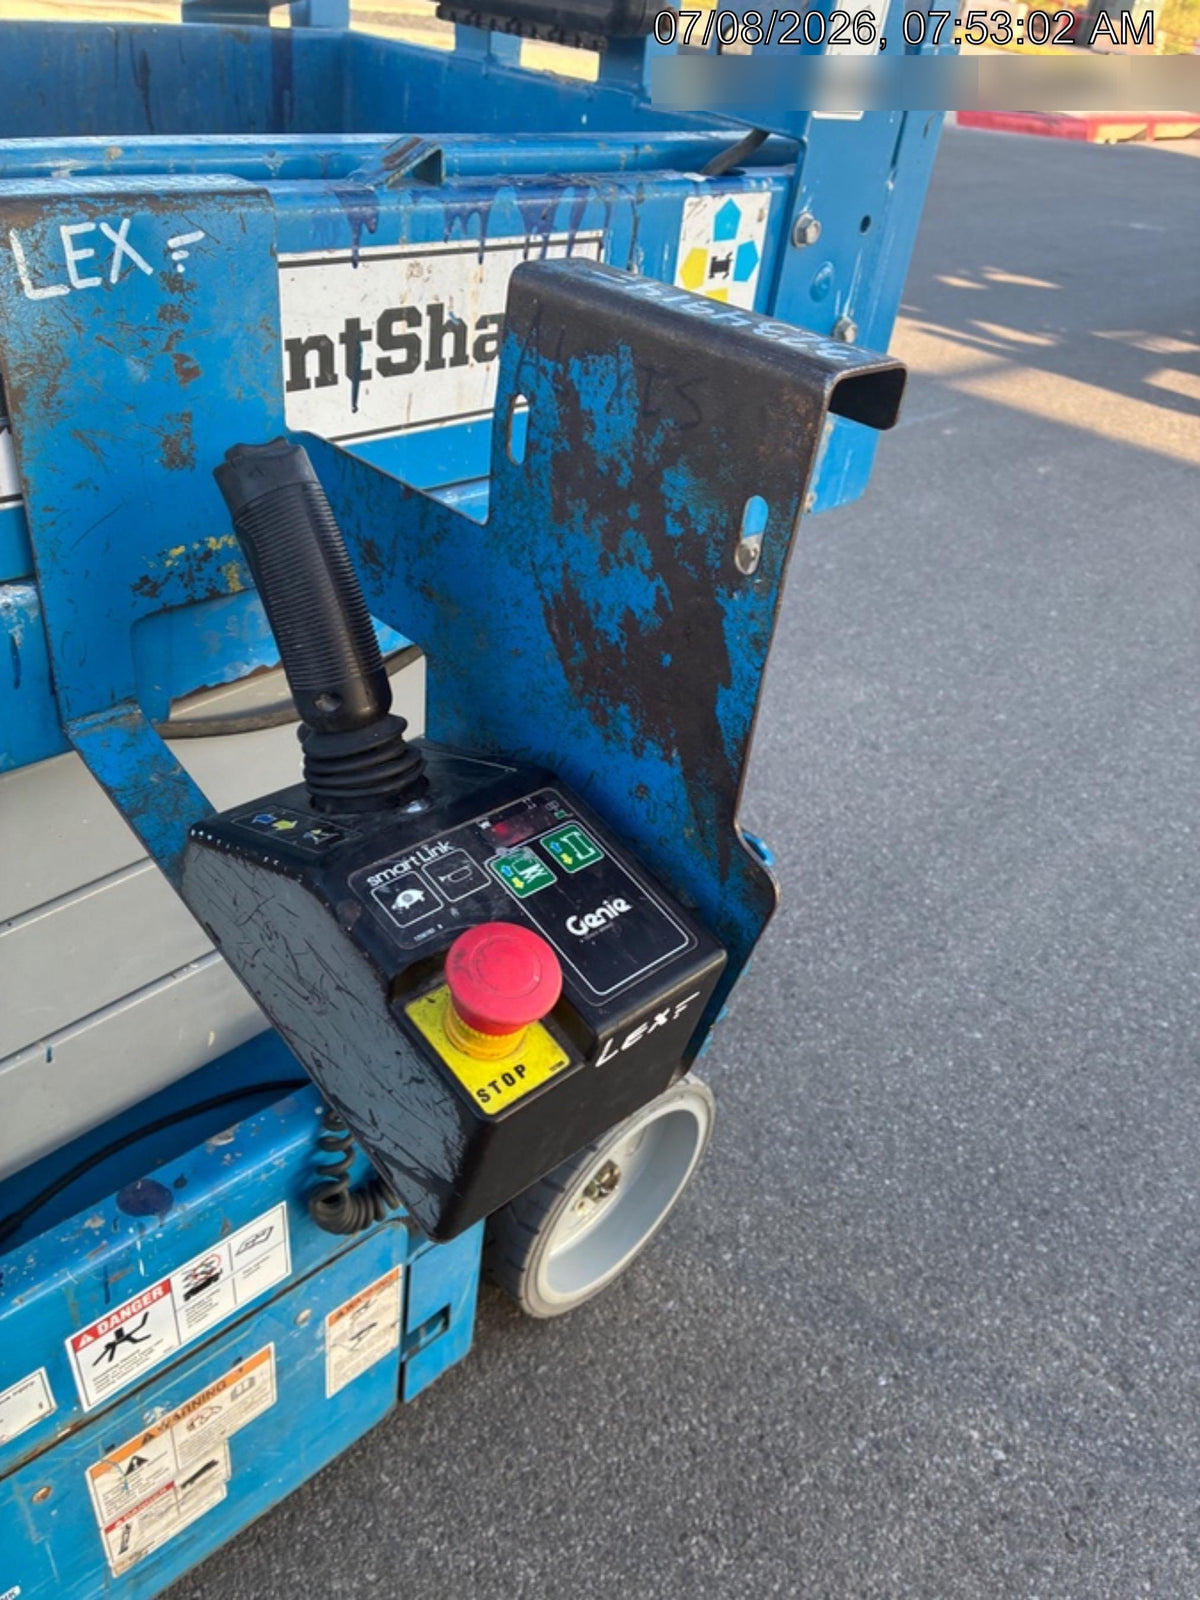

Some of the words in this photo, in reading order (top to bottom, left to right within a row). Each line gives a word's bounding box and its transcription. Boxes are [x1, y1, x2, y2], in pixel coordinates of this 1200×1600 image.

[565, 896, 633, 937] Genie
[475, 1064, 527, 1104] STOP
[96, 1284, 165, 1335] DANGER
